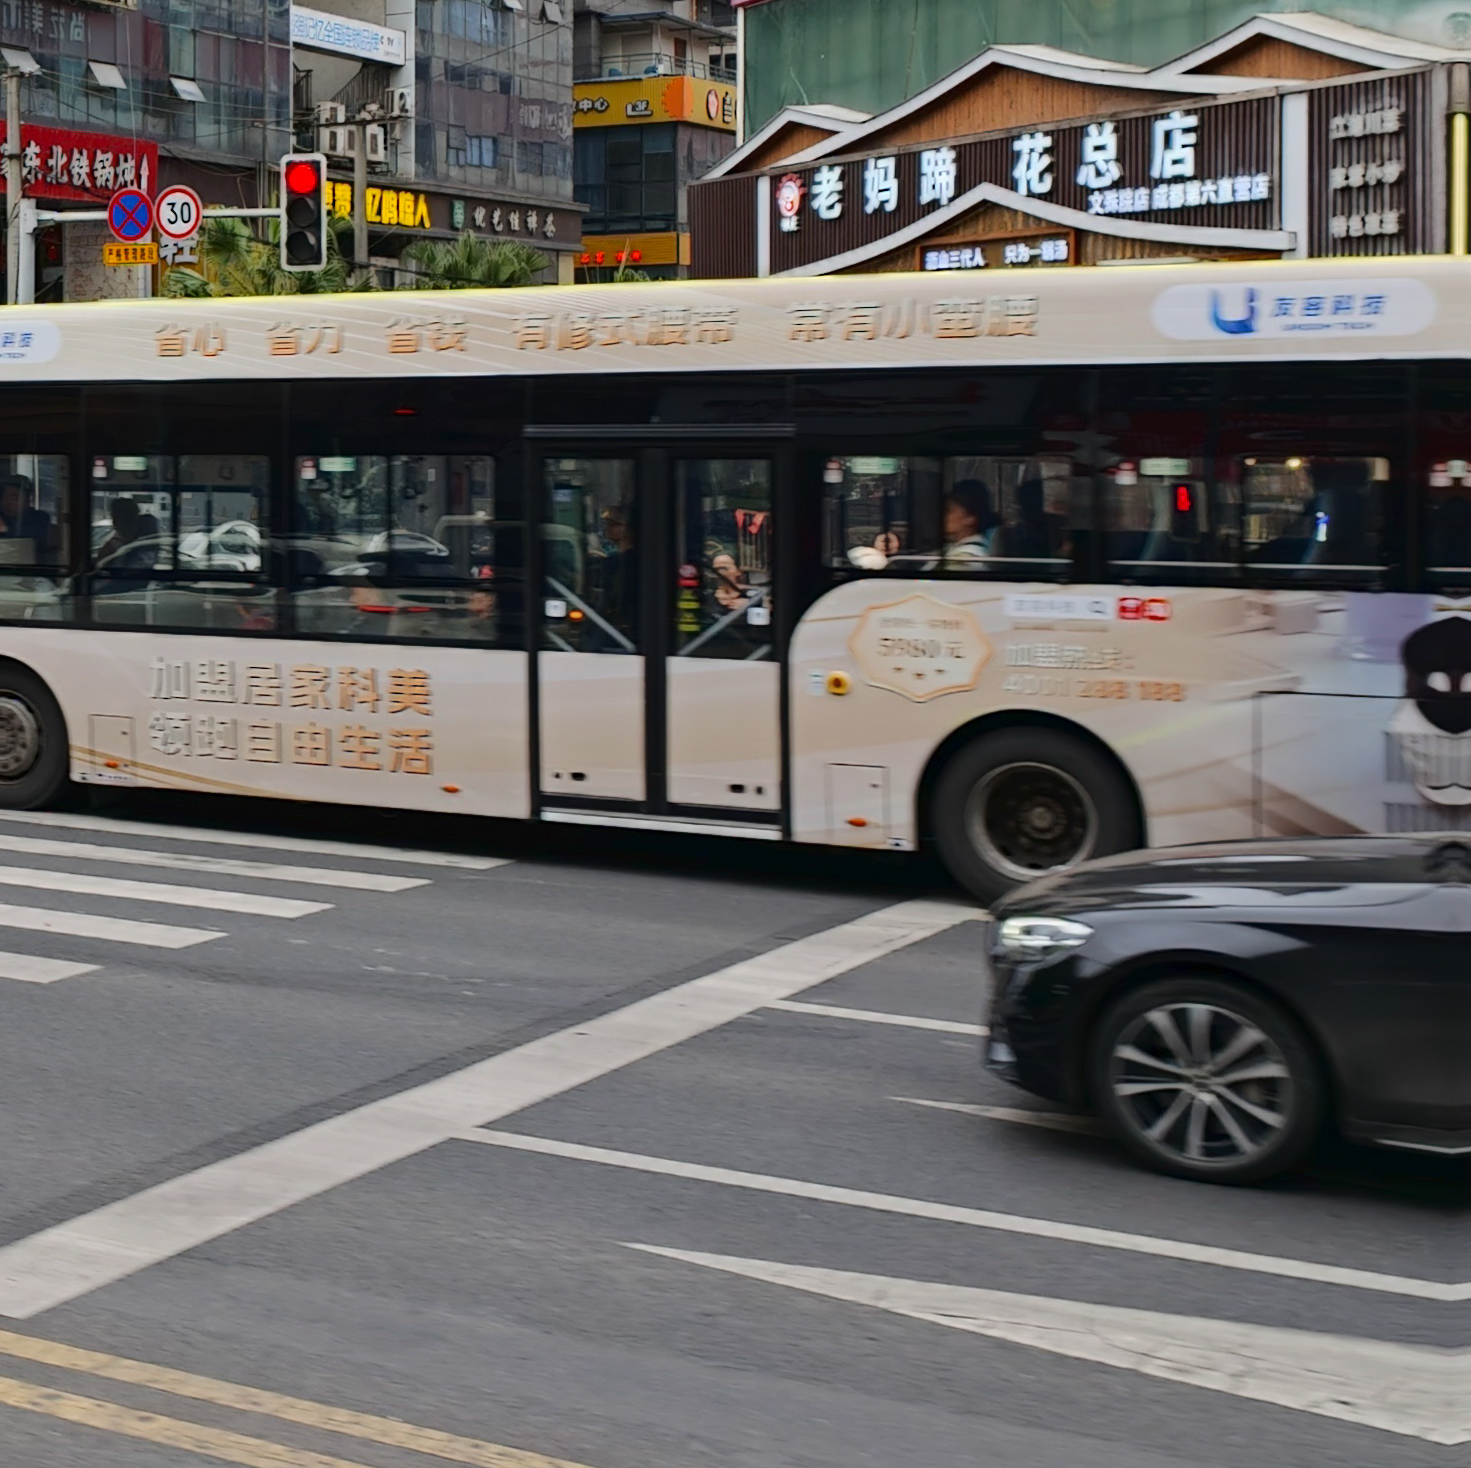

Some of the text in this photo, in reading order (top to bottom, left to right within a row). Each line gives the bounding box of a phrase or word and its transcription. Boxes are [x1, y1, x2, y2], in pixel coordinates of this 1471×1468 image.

[809, 110, 1200, 221] 老妈蹄花总店
[166, 201, 192, 225] 30
[153, 320, 226, 359] 省心
[265, 318, 344, 357] 省力
[384, 314, 469, 355] 省钱
[787, 293, 1041, 343] 常有小蛮腰
[149, 712, 435, 777] 领跑自由生活
